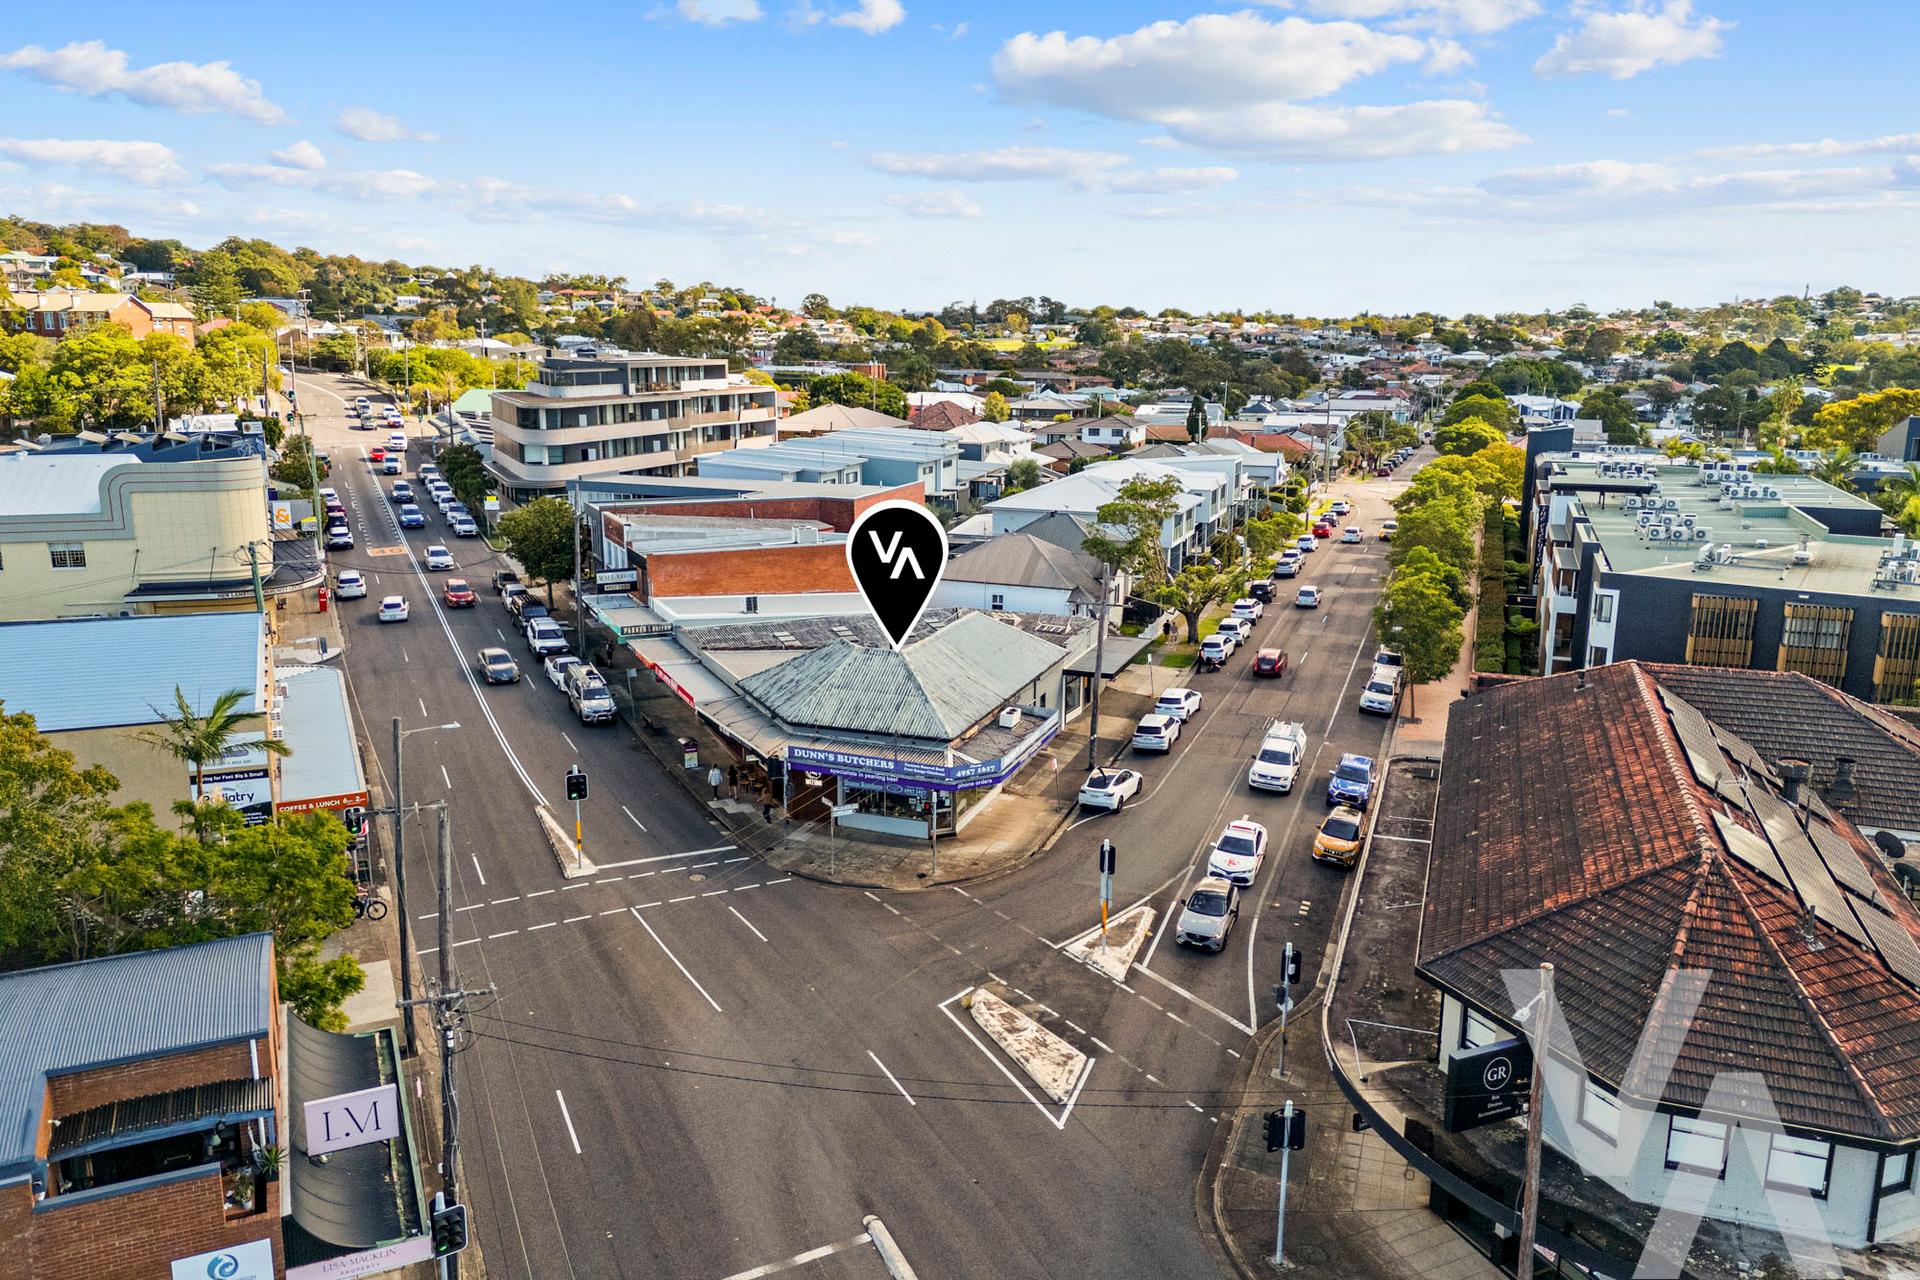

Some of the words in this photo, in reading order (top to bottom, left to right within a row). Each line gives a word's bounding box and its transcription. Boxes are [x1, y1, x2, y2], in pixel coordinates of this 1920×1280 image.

[794, 748, 835, 761] DUNN'S
[837, 755, 895, 769] BUTCHERS
[956, 768, 976, 777] 4957
[977, 765, 996, 774] 1617
[957, 781, 975, 789] phone
[203, 791, 255, 803] Piatry
[279, 804, 308, 813] COFFEE
[315, 799, 341, 808] LUNCH
[1487, 1066, 1507, 1081] GR
[322, 1260, 346, 1273] LISA
[349, 1248, 397, 1266] MACKLIN
